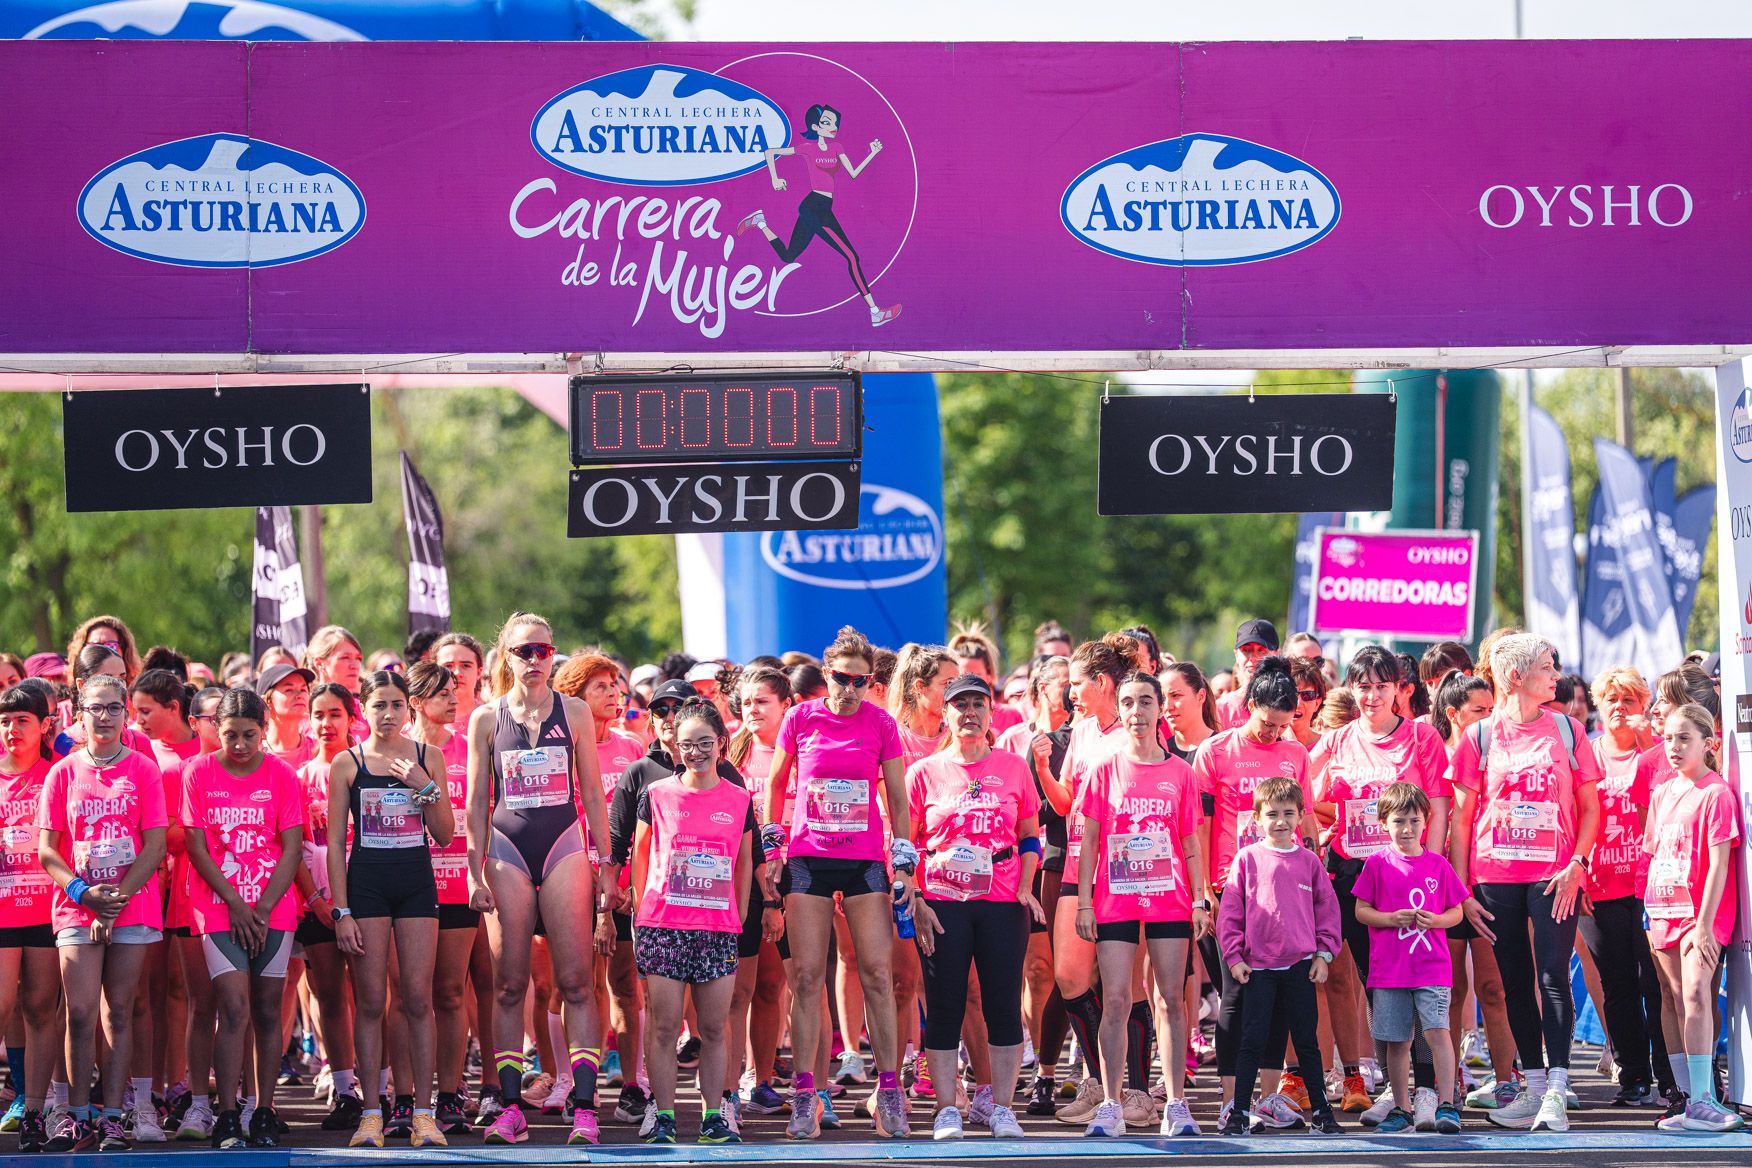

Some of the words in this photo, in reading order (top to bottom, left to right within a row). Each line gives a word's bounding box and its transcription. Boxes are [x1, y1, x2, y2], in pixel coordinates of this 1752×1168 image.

[592, 107, 672, 118] CENTRAL
[681, 107, 762, 118] LECHERA
[551, 109, 769, 154] ASTURIANA
[145, 180, 235, 193] CENTRAL
[245, 181, 335, 194] LECHERA
[1126, 181, 1212, 193] CENTRAL
[1221, 179, 1310, 192] LECHERA
[100, 182, 344, 234] ASTURIANA
[509, 177, 722, 241] Carrera
[1083, 183, 1320, 232] ASTURIANA
[1479, 183, 1694, 229] OYSHO
[561, 244, 600, 287] de
[610, 241, 638, 287] la
[632, 234, 802, 339] Mujer
[115, 424, 326, 472] OYSHO
[1148, 433, 1353, 476] OYSHO
[583, 472, 846, 528] OYSHO
[1407, 546, 1468, 565] OYSHO
[1319, 576, 1467, 606] CORREDORAS
[524, 775, 549, 785] 016
[1526, 770, 1544, 791] DE
[207, 807, 265, 826] CARRERA
[825, 803, 850, 812] 016
[382, 816, 405, 826] 016
[972, 812, 992, 833] DE
[236, 831, 255, 853] DE
[1512, 829, 1536, 838] 016
[6, 854, 31, 864] 016
[1600, 845, 1642, 865] MUJER
[91, 867, 117, 878] 016
[1130, 860, 1153, 871] 016
[687, 877, 712, 888] 016
[946, 871, 971, 882] 016
[1656, 886, 1674, 896] 016
[16, 897, 33, 906] 2026
